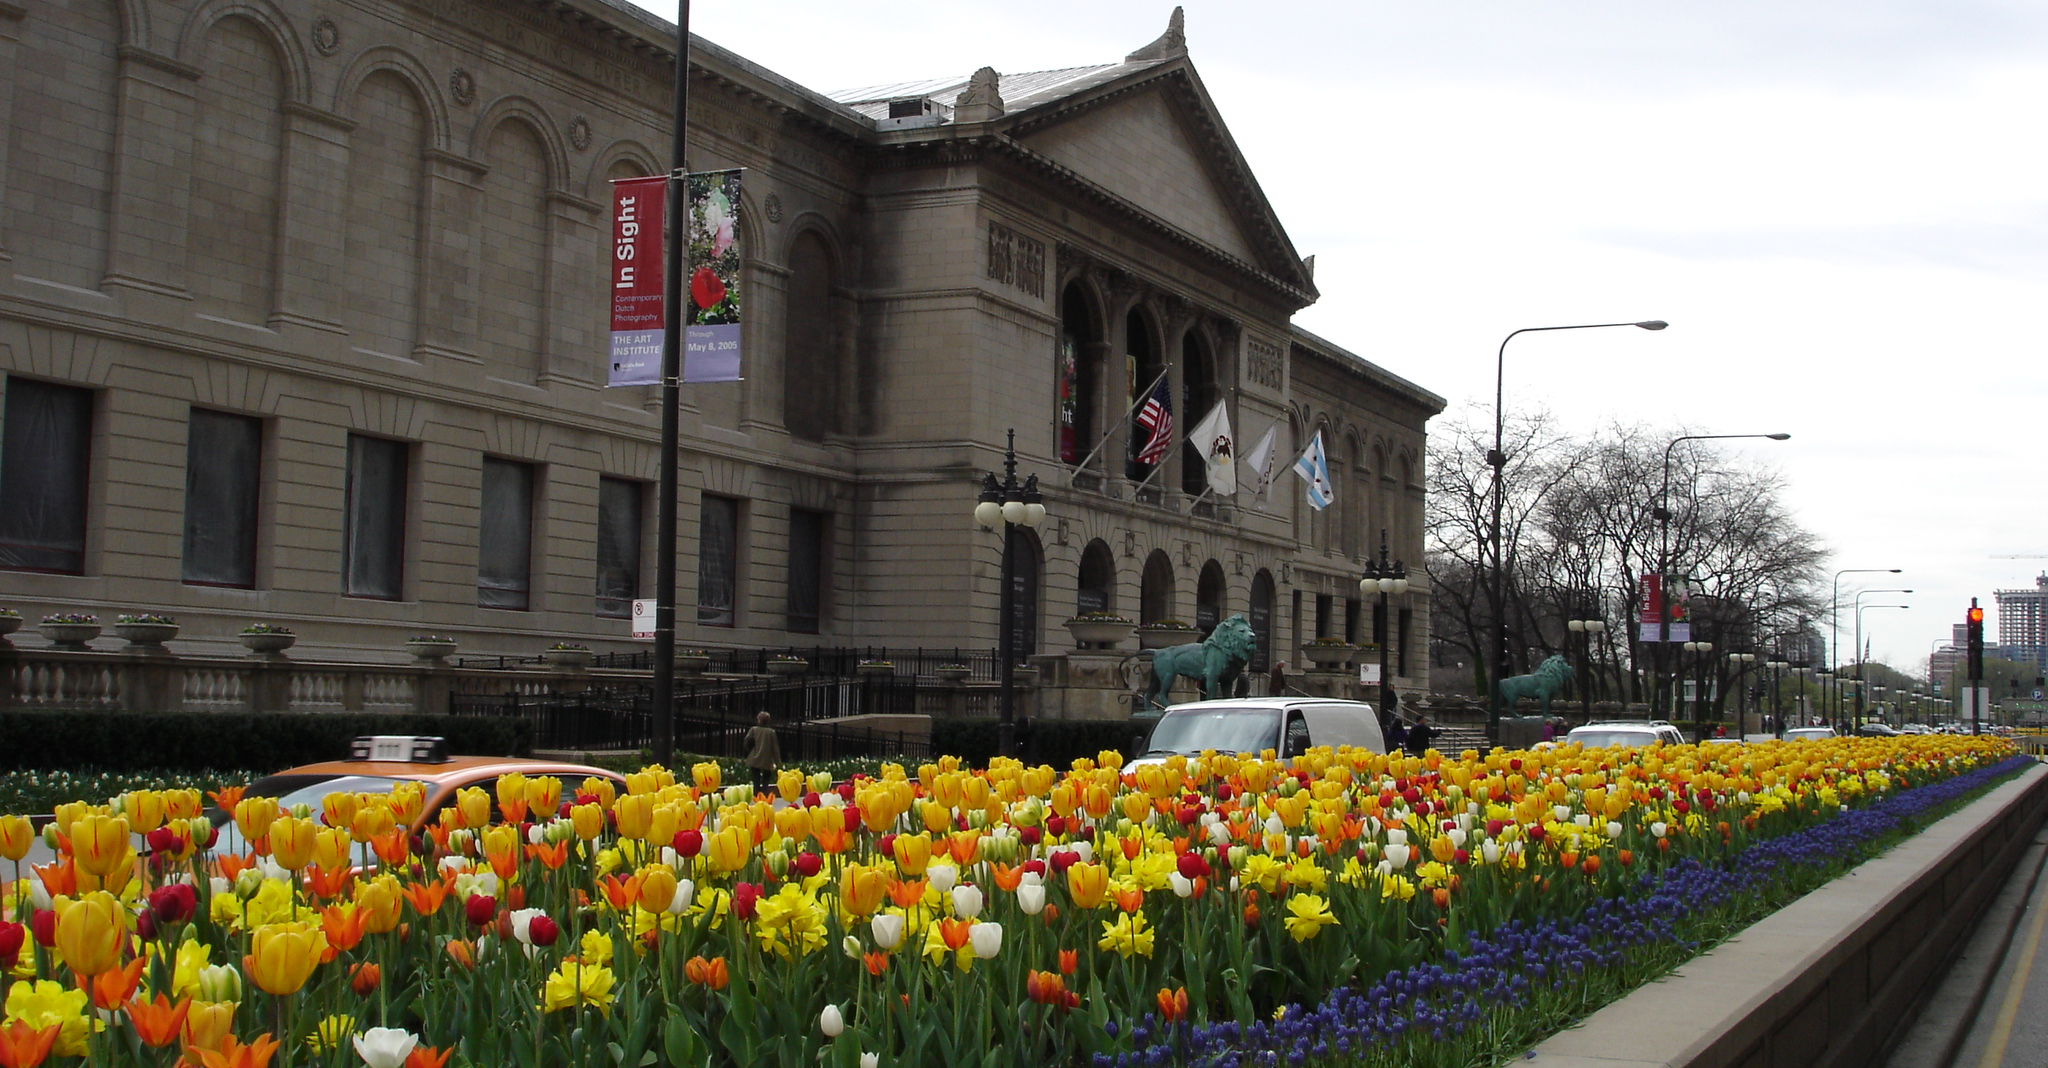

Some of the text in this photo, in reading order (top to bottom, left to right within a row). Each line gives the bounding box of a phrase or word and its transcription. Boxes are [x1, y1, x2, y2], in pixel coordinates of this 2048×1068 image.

[616, 196, 640, 289] In Sight
[615, 294, 663, 303] Contemporary
[614, 314, 658, 323] Photography
[614, 334, 652, 345] THE ART
[688, 331, 714, 339] Through
[613, 345, 660, 356] INSTITUTE
[688, 340, 738, 353] May 8, 2005
[1642, 580, 1651, 602] Sight
[1642, 602, 1650, 611] In
